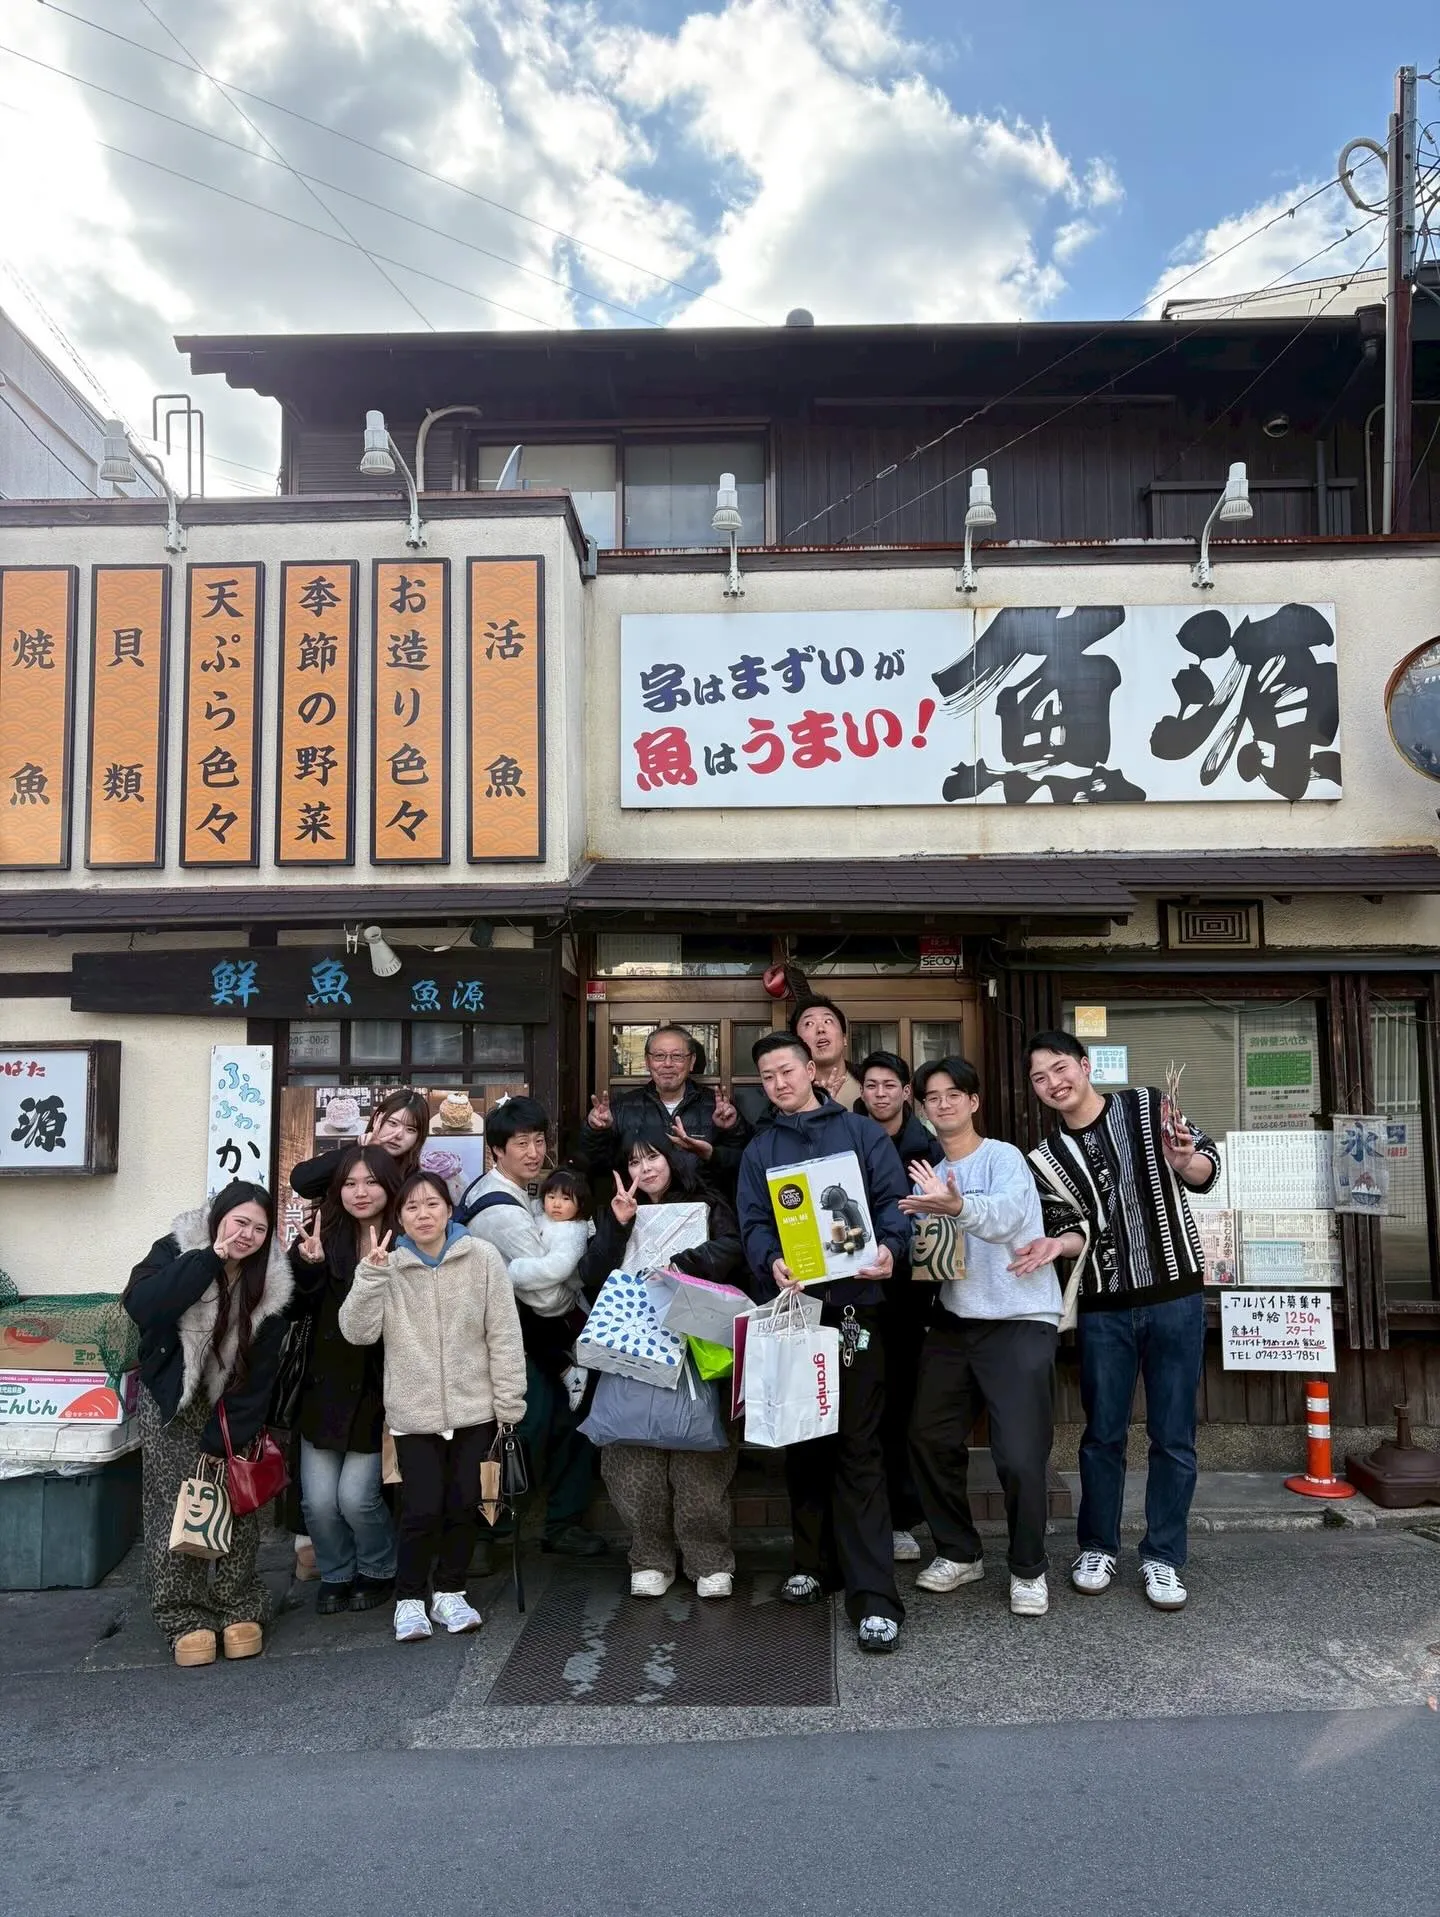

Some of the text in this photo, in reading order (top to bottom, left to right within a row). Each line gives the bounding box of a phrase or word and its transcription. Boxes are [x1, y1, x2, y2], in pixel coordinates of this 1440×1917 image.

[384, 574, 432, 842] お造り色々
[640, 644, 906, 713] 字はまずいが
[931, 602, 1343, 803] 魚源
[9, 628, 56, 806] 焼魚
[103, 627, 145, 803] 貝類
[195, 579, 245, 845] 天ぷら色々
[294, 575, 341, 844] 季節の野菜
[482, 618, 527, 799] 活魚
[210, 956, 353, 1008] 鮮魚
[921, 955, 960, 966] SECOM
[410, 978, 486, 1013] 魚源
[11, 1095, 67, 1152] 源
[1340, 1120, 1383, 1162] 氷
[1230, 1295, 1321, 1309] アルバイト募集中
[1252, 1311, 1281, 1323] 時給
[1286, 1325, 1315, 1336] スタート
[813, 1353, 831, 1415] graniph
[1230, 1350, 1320, 1361] TEL 0742-33-7851
